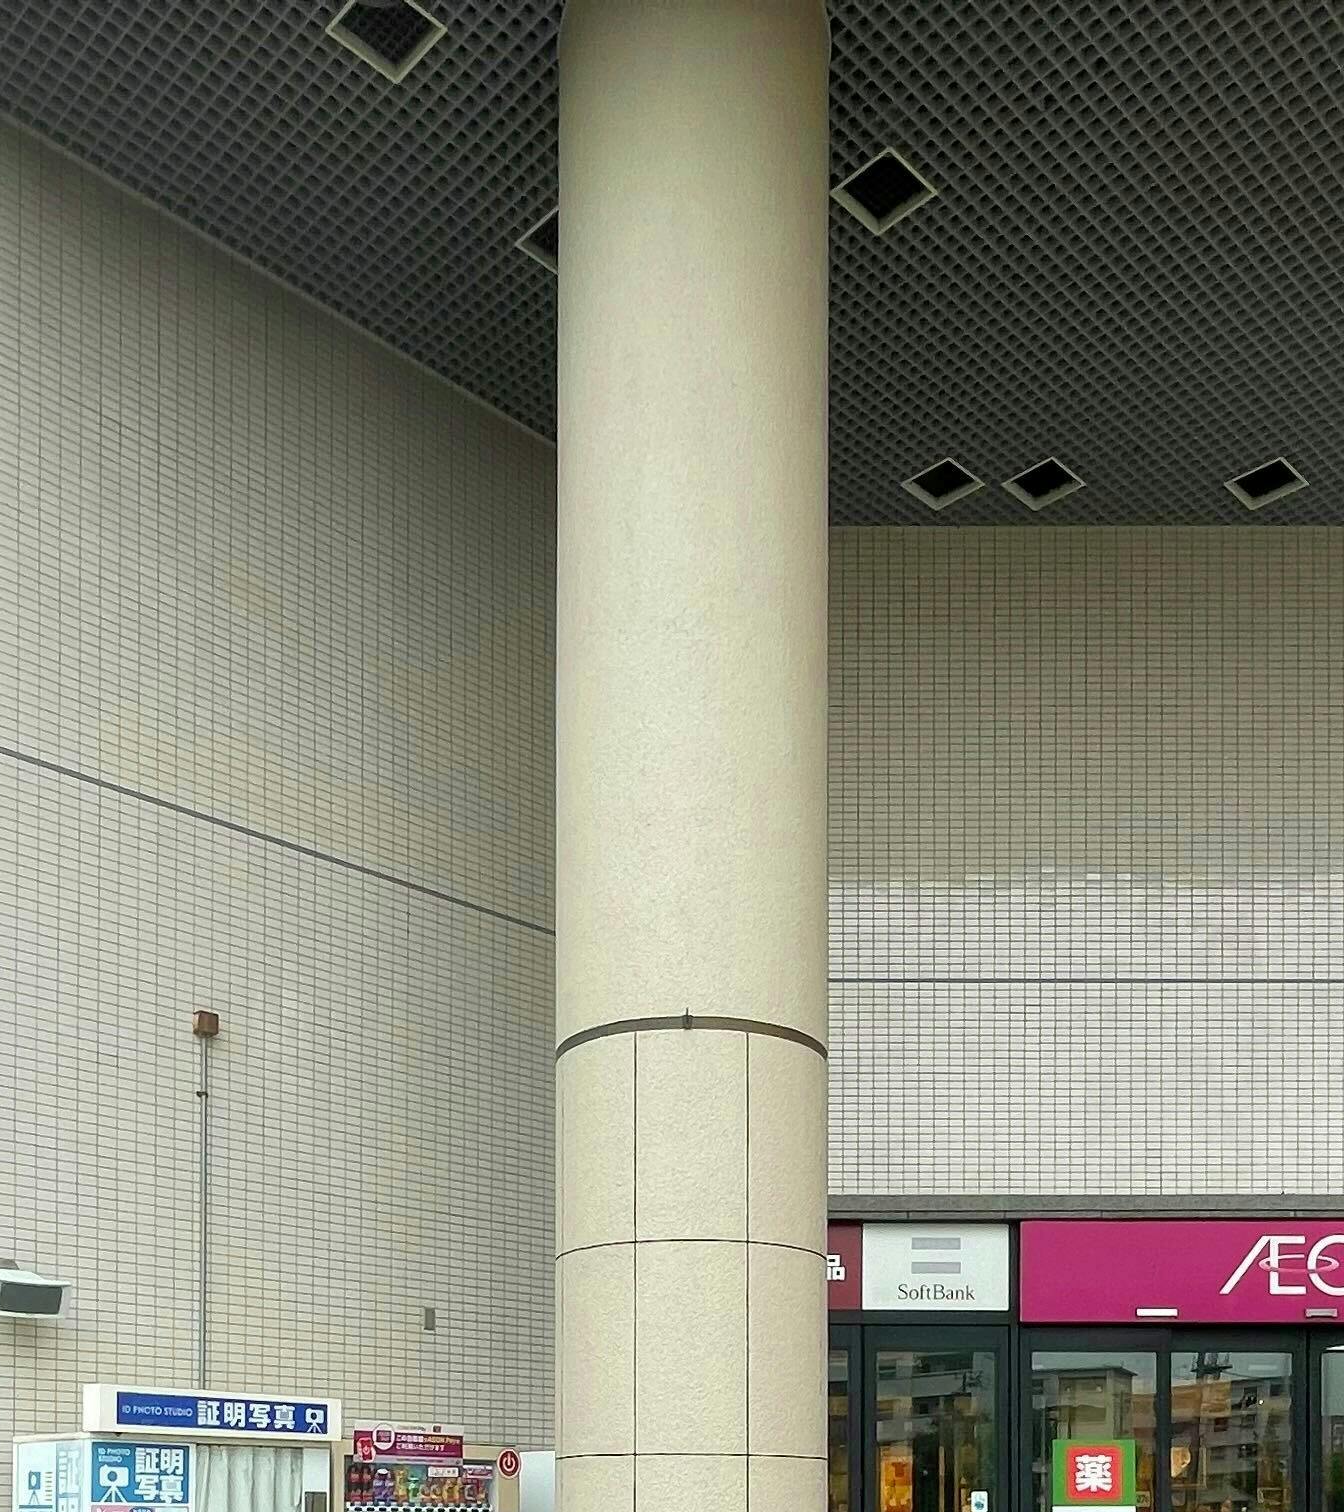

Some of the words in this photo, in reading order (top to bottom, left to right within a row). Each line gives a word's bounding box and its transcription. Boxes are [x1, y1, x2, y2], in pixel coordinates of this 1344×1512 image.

[897, 1283, 976, 1301] SoftBank
[121, 1405, 130, 1414] ID
[133, 1406, 163, 1416] PHOTO
[164, 1406, 193, 1417] STUDIO
[197, 1400, 296, 1430] 証明写真
[135, 1447, 184, 1475] 証明
[1074, 1454, 1113, 1493] 薬
[134, 1474, 184, 1504] 写真
